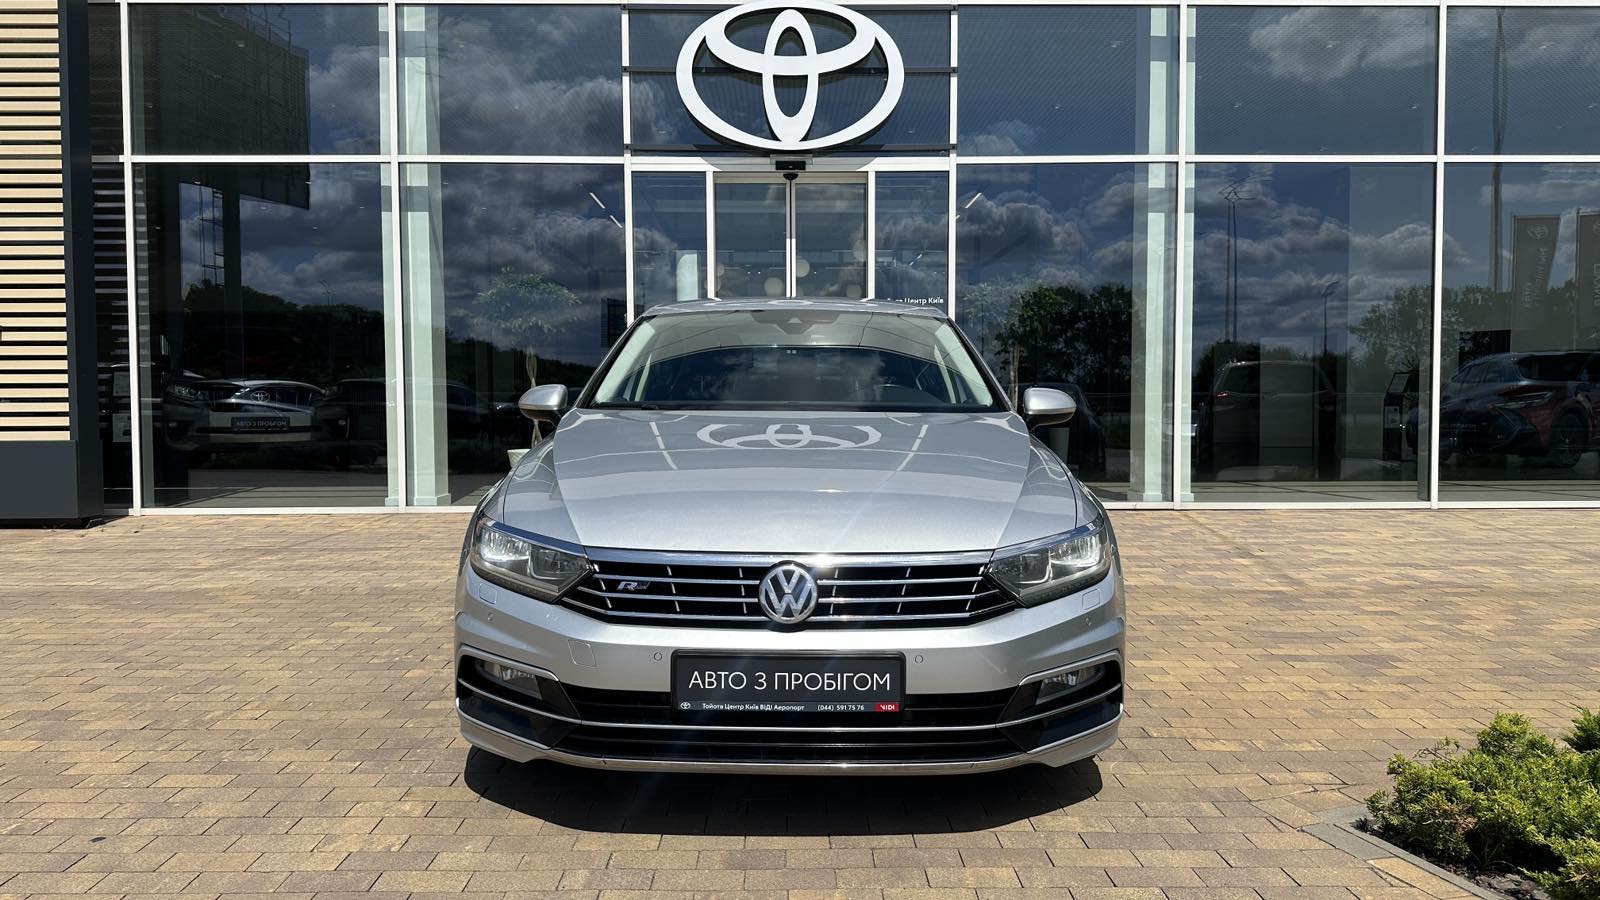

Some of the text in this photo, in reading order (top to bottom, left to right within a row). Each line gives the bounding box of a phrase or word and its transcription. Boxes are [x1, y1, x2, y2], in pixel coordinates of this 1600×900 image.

[688, 671, 747, 690] АВТО
[774, 672, 891, 691] ПРОБІГОМ
[724, 703, 745, 711] Центр
[773, 704, 805, 712] Аеропорт
[817, 704, 835, 712] (044)
